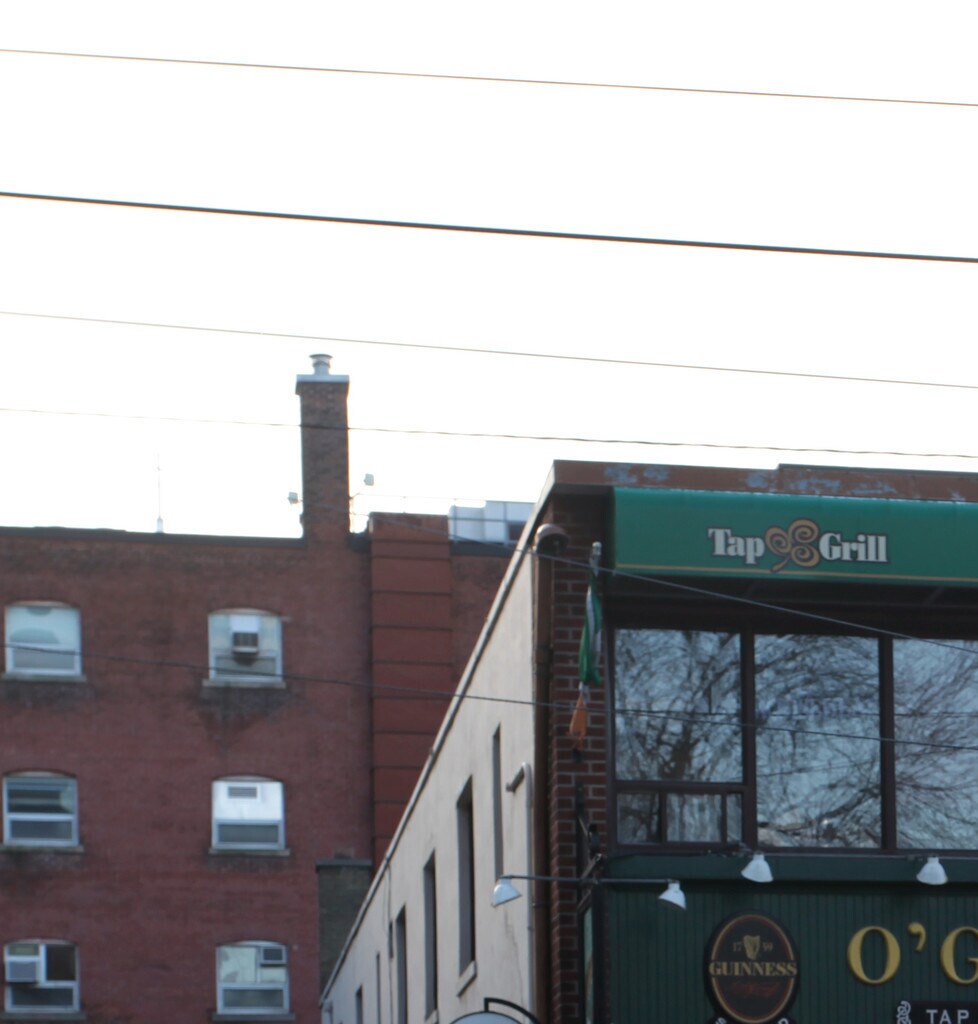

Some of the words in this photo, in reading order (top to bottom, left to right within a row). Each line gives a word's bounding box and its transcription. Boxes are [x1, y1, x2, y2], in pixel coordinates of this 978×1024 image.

[708, 527, 765, 565] Tap
[819, 530, 888, 563] Grill
[708, 960, 798, 977] GUINNESS
